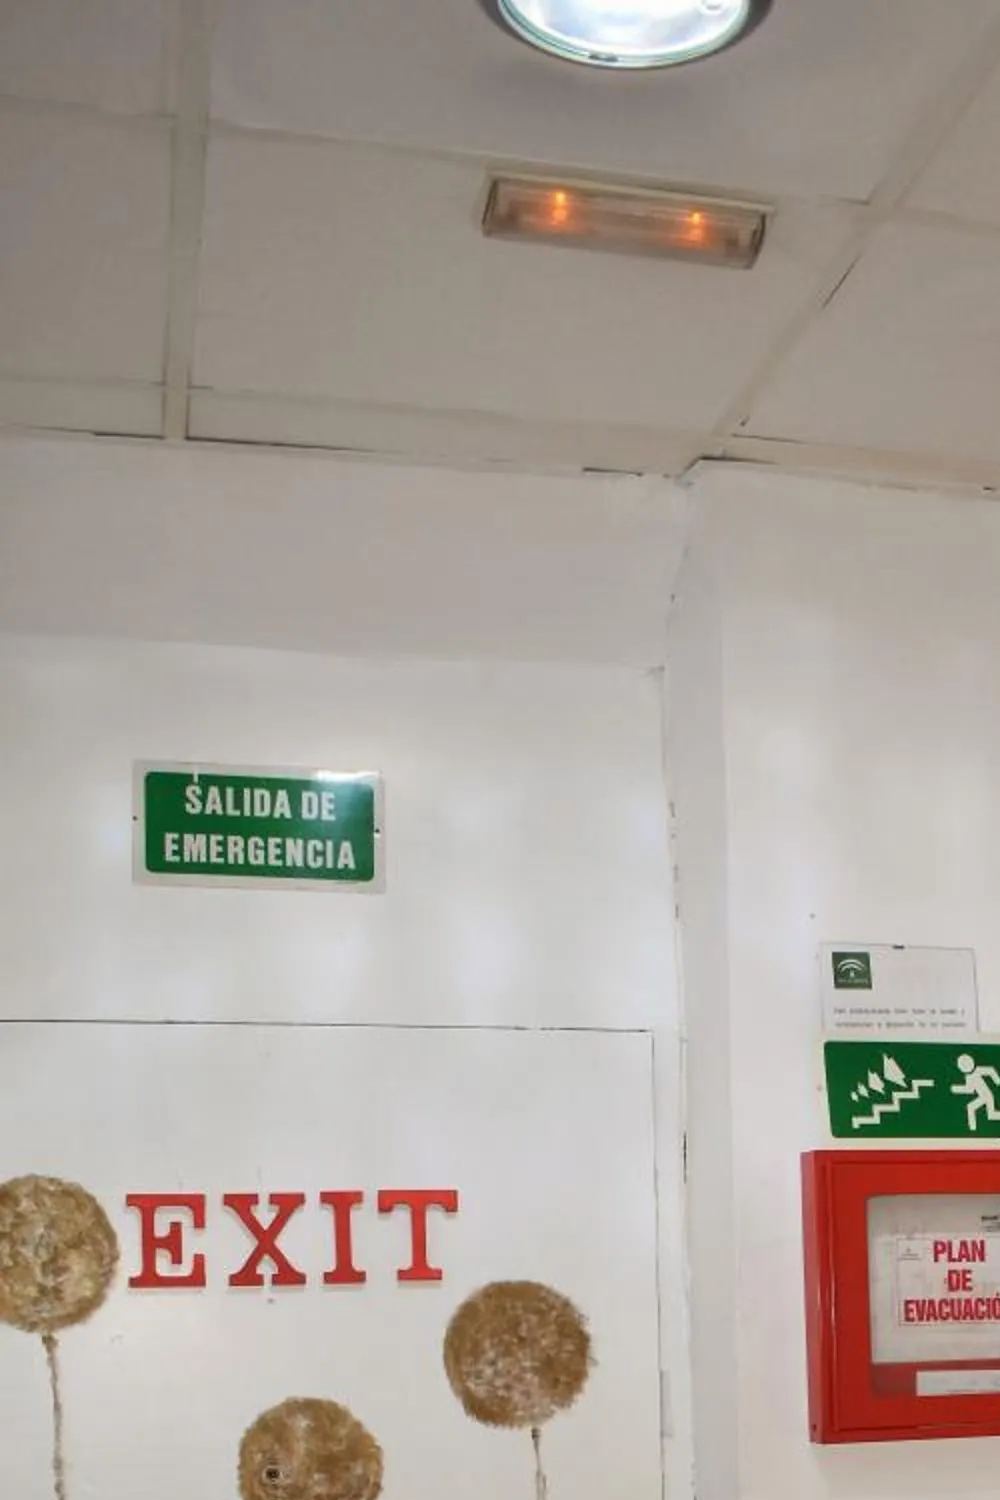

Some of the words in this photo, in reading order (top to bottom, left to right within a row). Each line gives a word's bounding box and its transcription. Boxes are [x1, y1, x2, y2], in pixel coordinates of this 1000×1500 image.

[185, 784, 292, 819] SALIDA
[301, 791, 337, 821] DE
[163, 832, 356, 870] EMERGENCIA
[125, 1190, 459, 1288] EXIT
[933, 1239, 986, 1262] PLAN
[947, 1269, 973, 1292] DE
